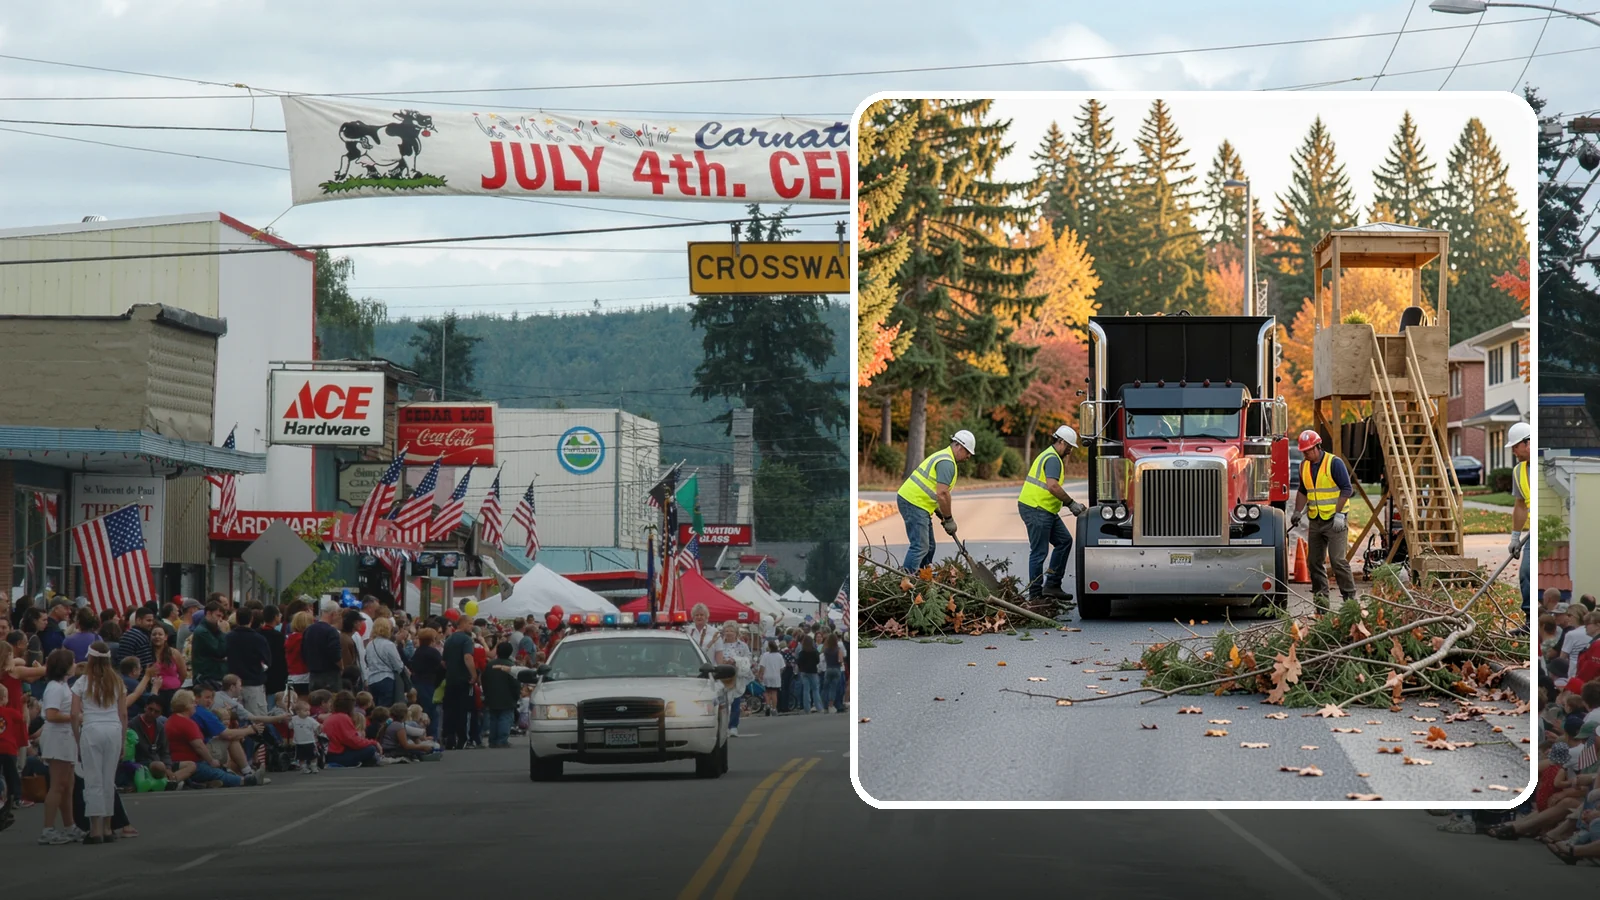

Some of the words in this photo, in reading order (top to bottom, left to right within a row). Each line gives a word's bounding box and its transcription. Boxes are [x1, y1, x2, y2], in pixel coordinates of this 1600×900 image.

[695, 121, 850, 149] Carnat
[481, 140, 604, 192] JULY
[632, 150, 746, 198] 4th.
[697, 254, 850, 280] CROSSWA
[282, 380, 373, 420] ACE
[406, 409, 452, 422] CEDAR
[461, 409, 485, 422] LOG
[283, 421, 371, 436] Hardware
[95, 485, 124, 495] Vincent
[126, 486, 136, 495] de
[137, 486, 155, 495] Paul
[688, 526, 741, 535] CRNATION
[699, 535, 730, 543] GLASS
